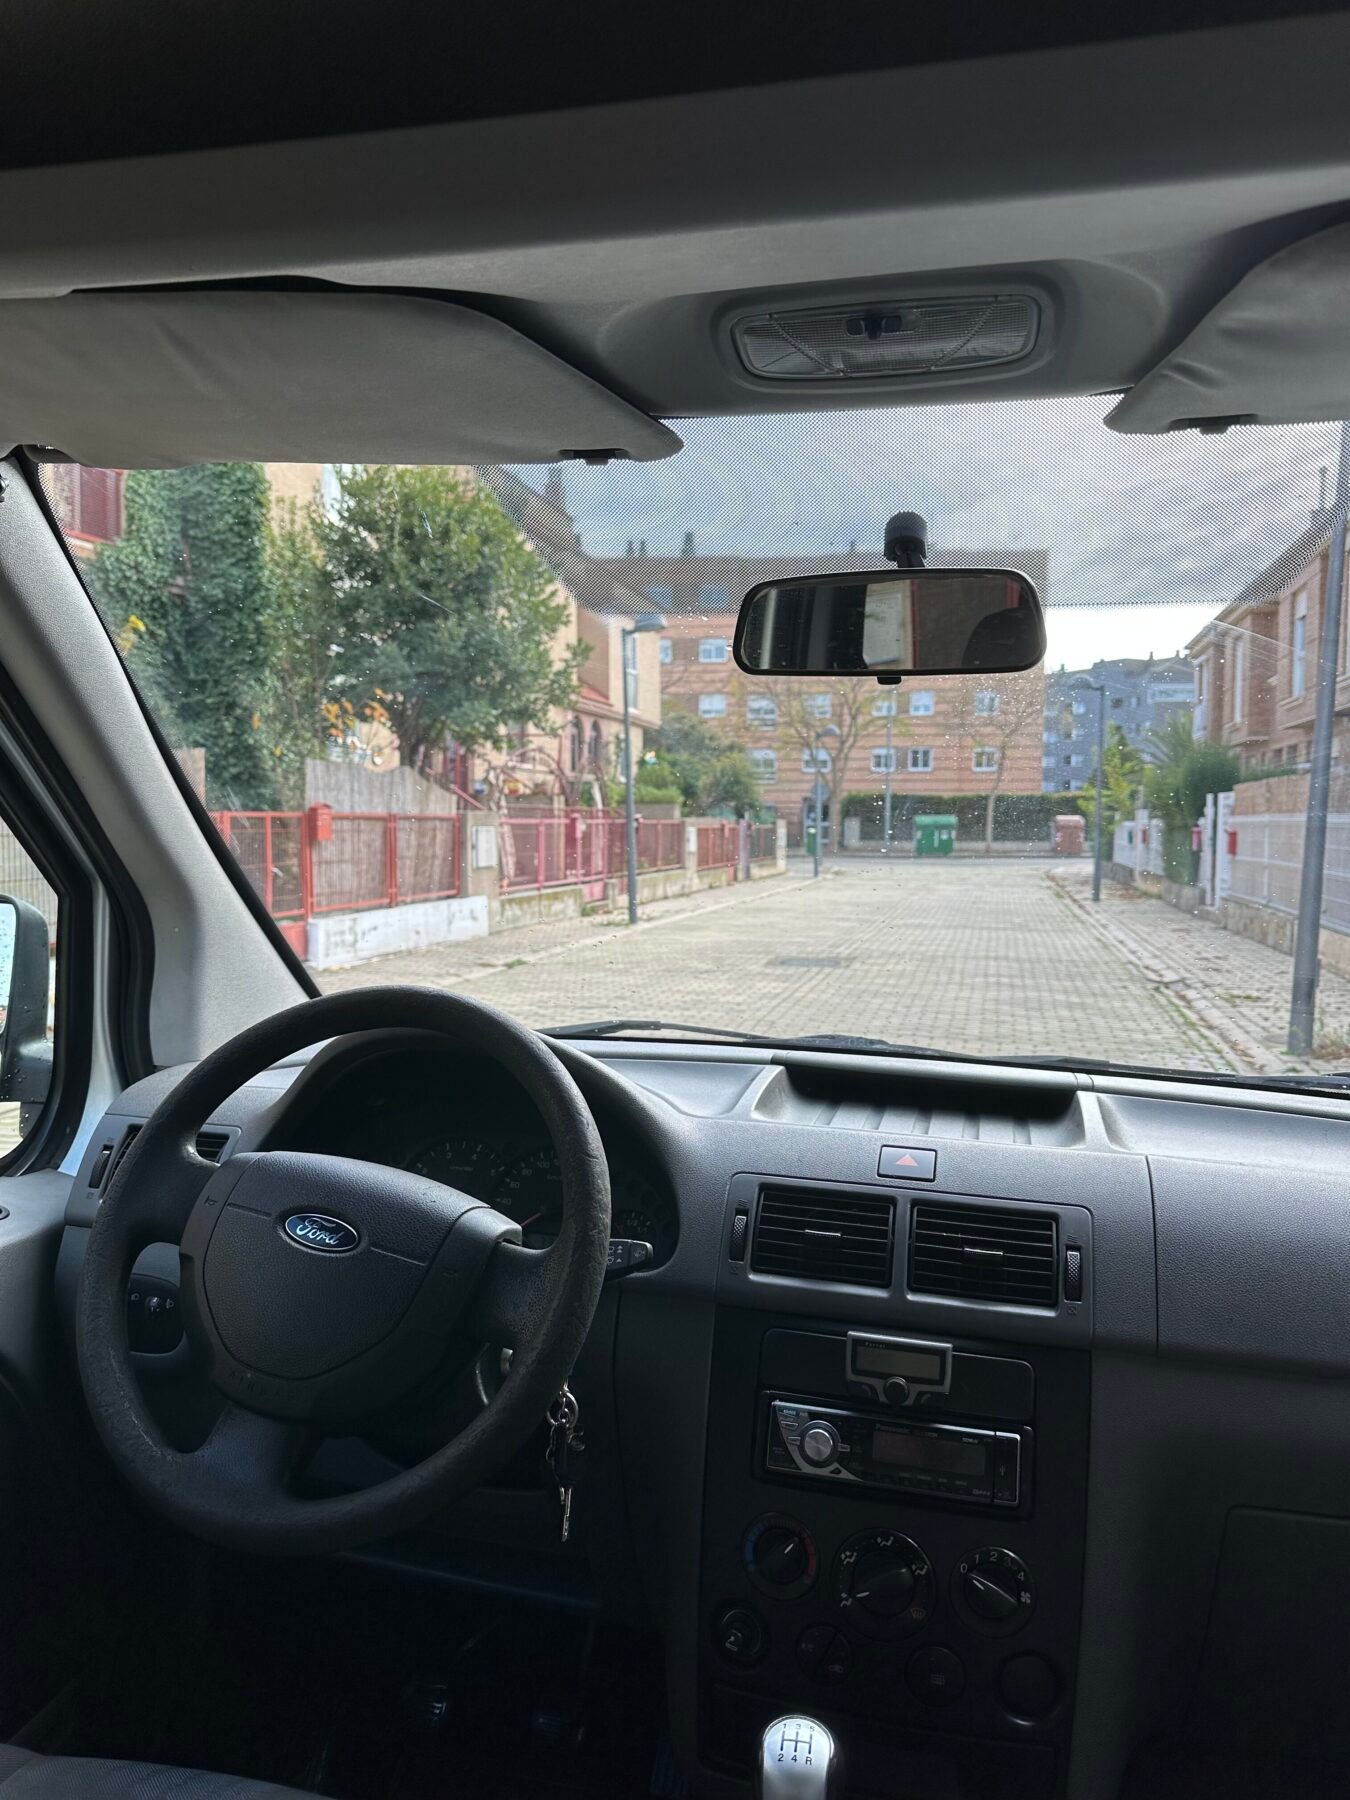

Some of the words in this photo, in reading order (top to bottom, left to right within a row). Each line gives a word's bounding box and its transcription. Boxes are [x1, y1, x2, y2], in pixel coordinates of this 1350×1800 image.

[296, 1217, 345, 1245] Ford
[960, 1563, 968, 1574] 0
[974, 1554, 980, 1565] 1
[990, 1551, 998, 1562] 2
[1017, 1571, 1025, 1581] 4
[777, 1753, 784, 1762] 2
[791, 1754, 798, 1763] 4
[805, 1756, 813, 1766] R
